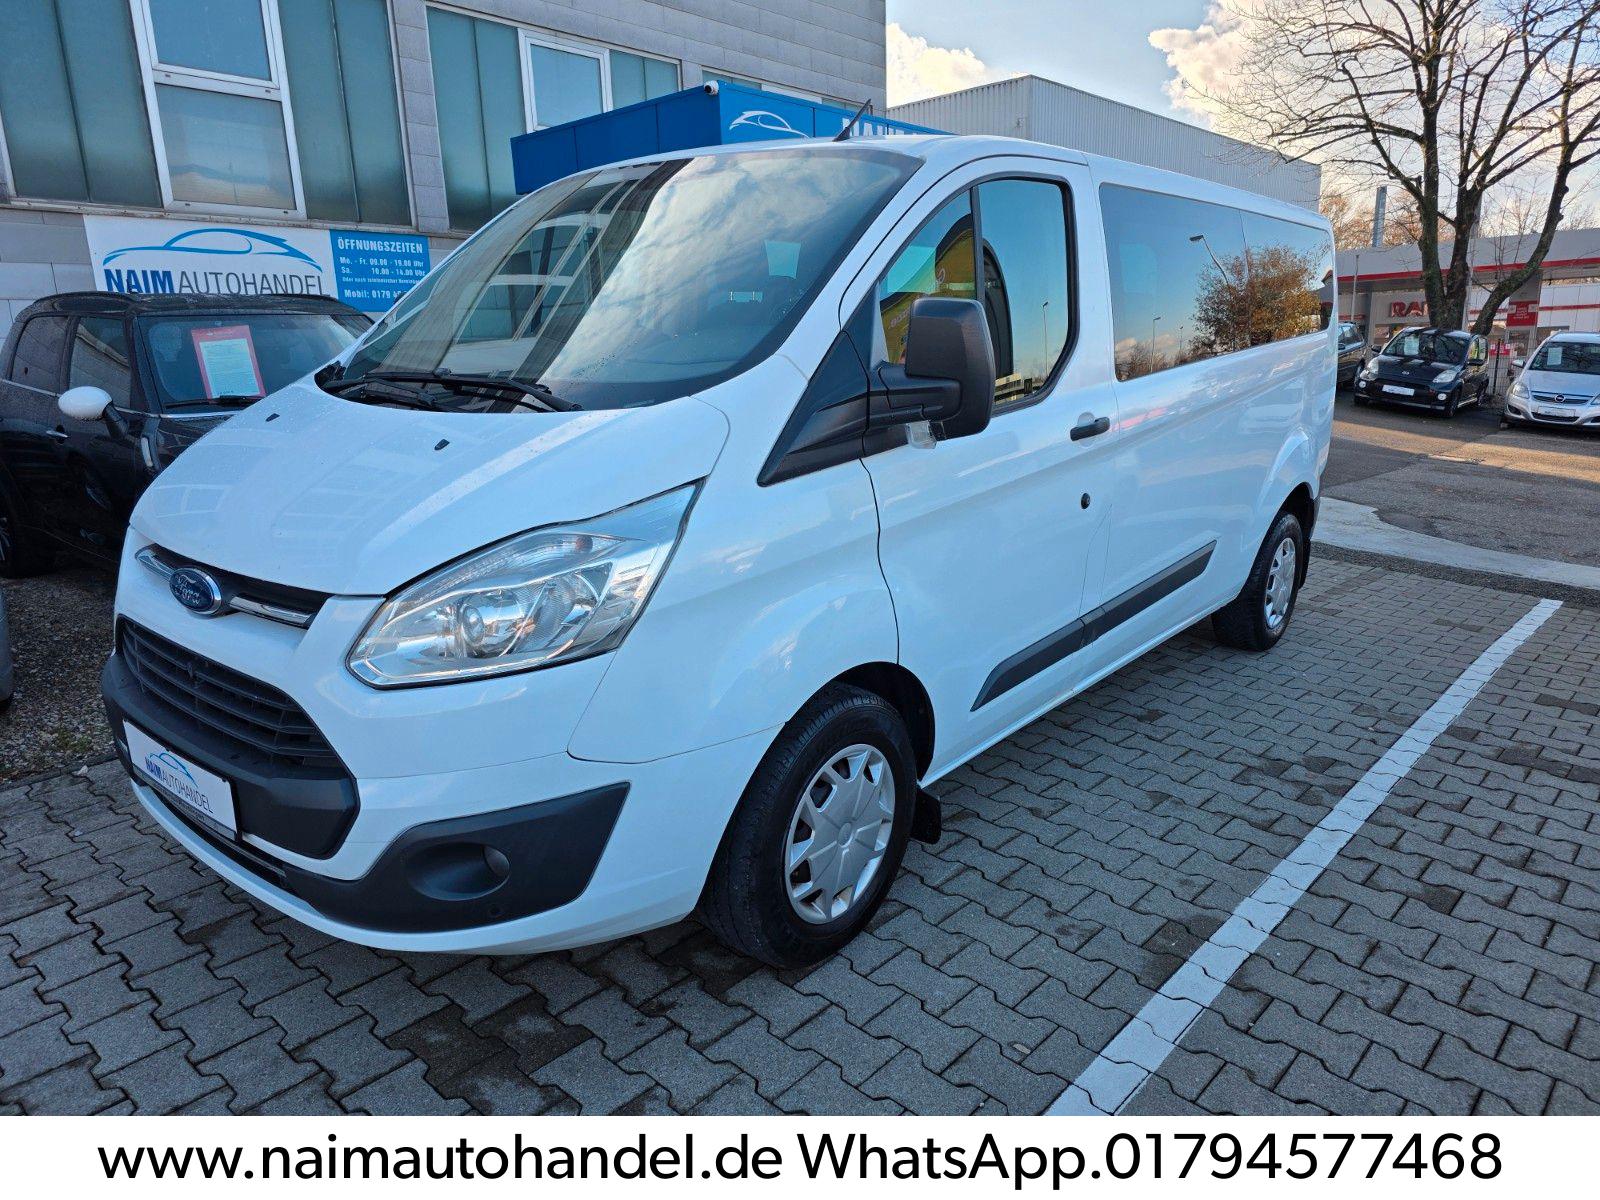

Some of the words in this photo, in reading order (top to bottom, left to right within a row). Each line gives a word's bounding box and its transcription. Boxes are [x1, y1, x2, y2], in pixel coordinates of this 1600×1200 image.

[337, 236, 423, 254] ÖFFNUNGSZEITEN
[341, 266, 353, 274] Sa.
[104, 268, 174, 294] NAIM
[178, 271, 330, 296] AUTOHANDEL
[344, 289, 370, 298] Mobil:
[371, 290, 391, 299] 0179
[175, 573, 201, 605] Ford
[161, 769, 214, 814] AUTOHANDEL
